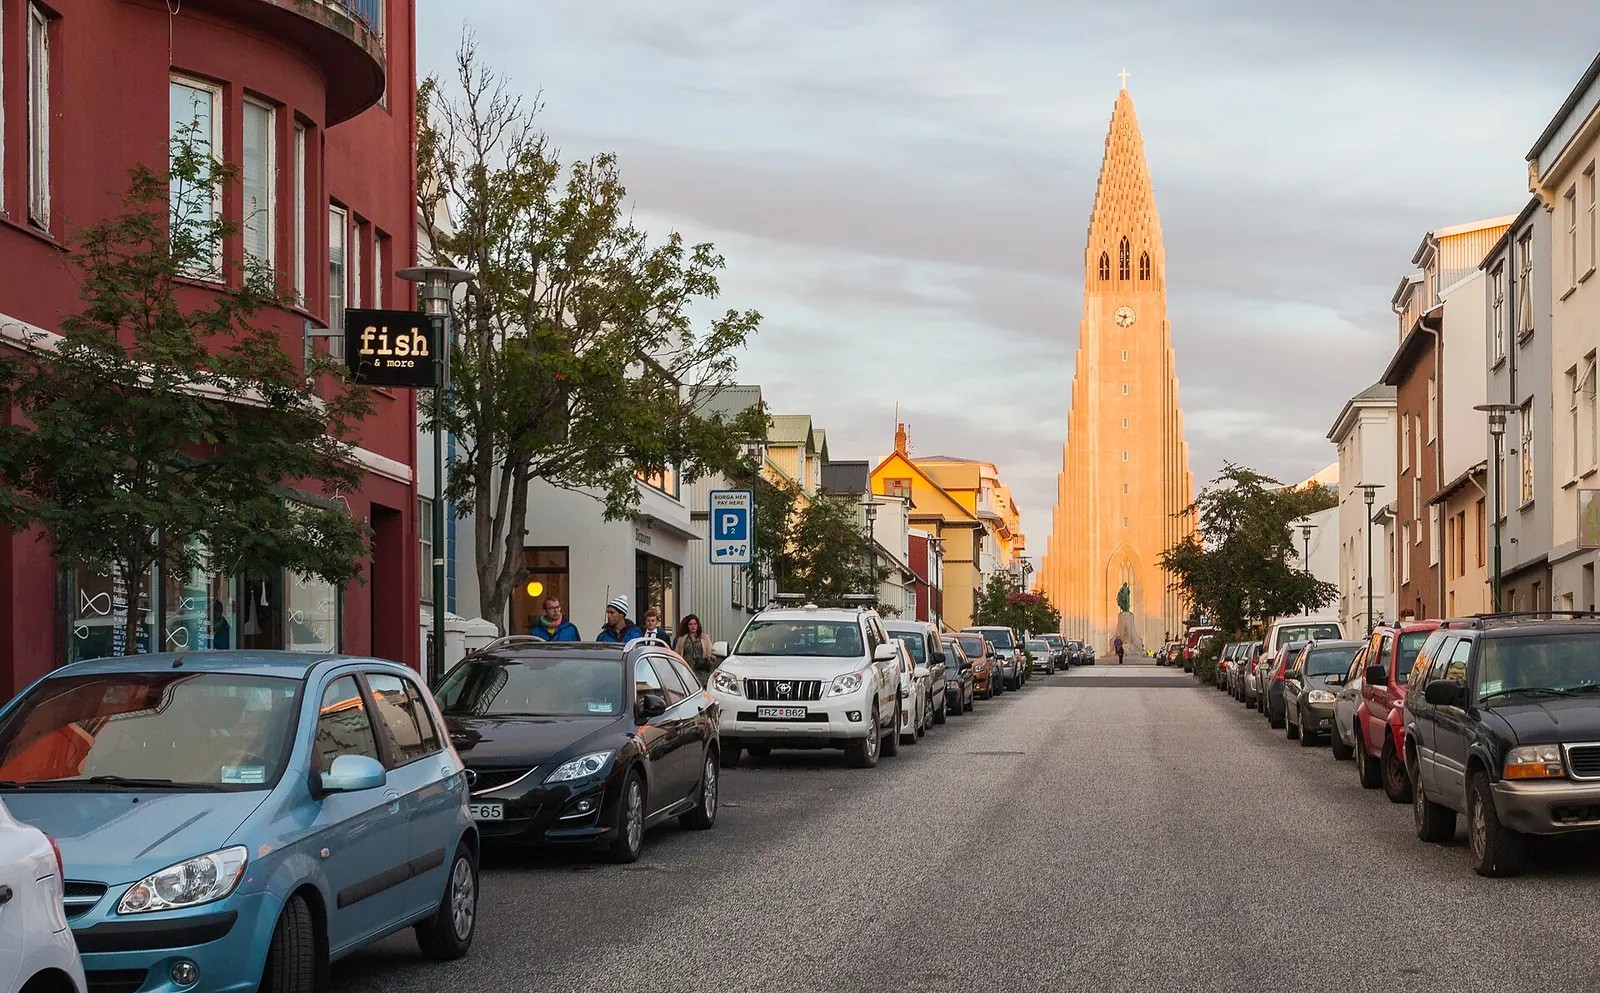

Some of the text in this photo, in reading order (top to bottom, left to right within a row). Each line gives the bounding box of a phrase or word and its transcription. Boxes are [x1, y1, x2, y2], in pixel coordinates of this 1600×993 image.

[360, 326, 429, 356] fish
[374, 358, 414, 368] & more
[722, 513, 739, 535] P
